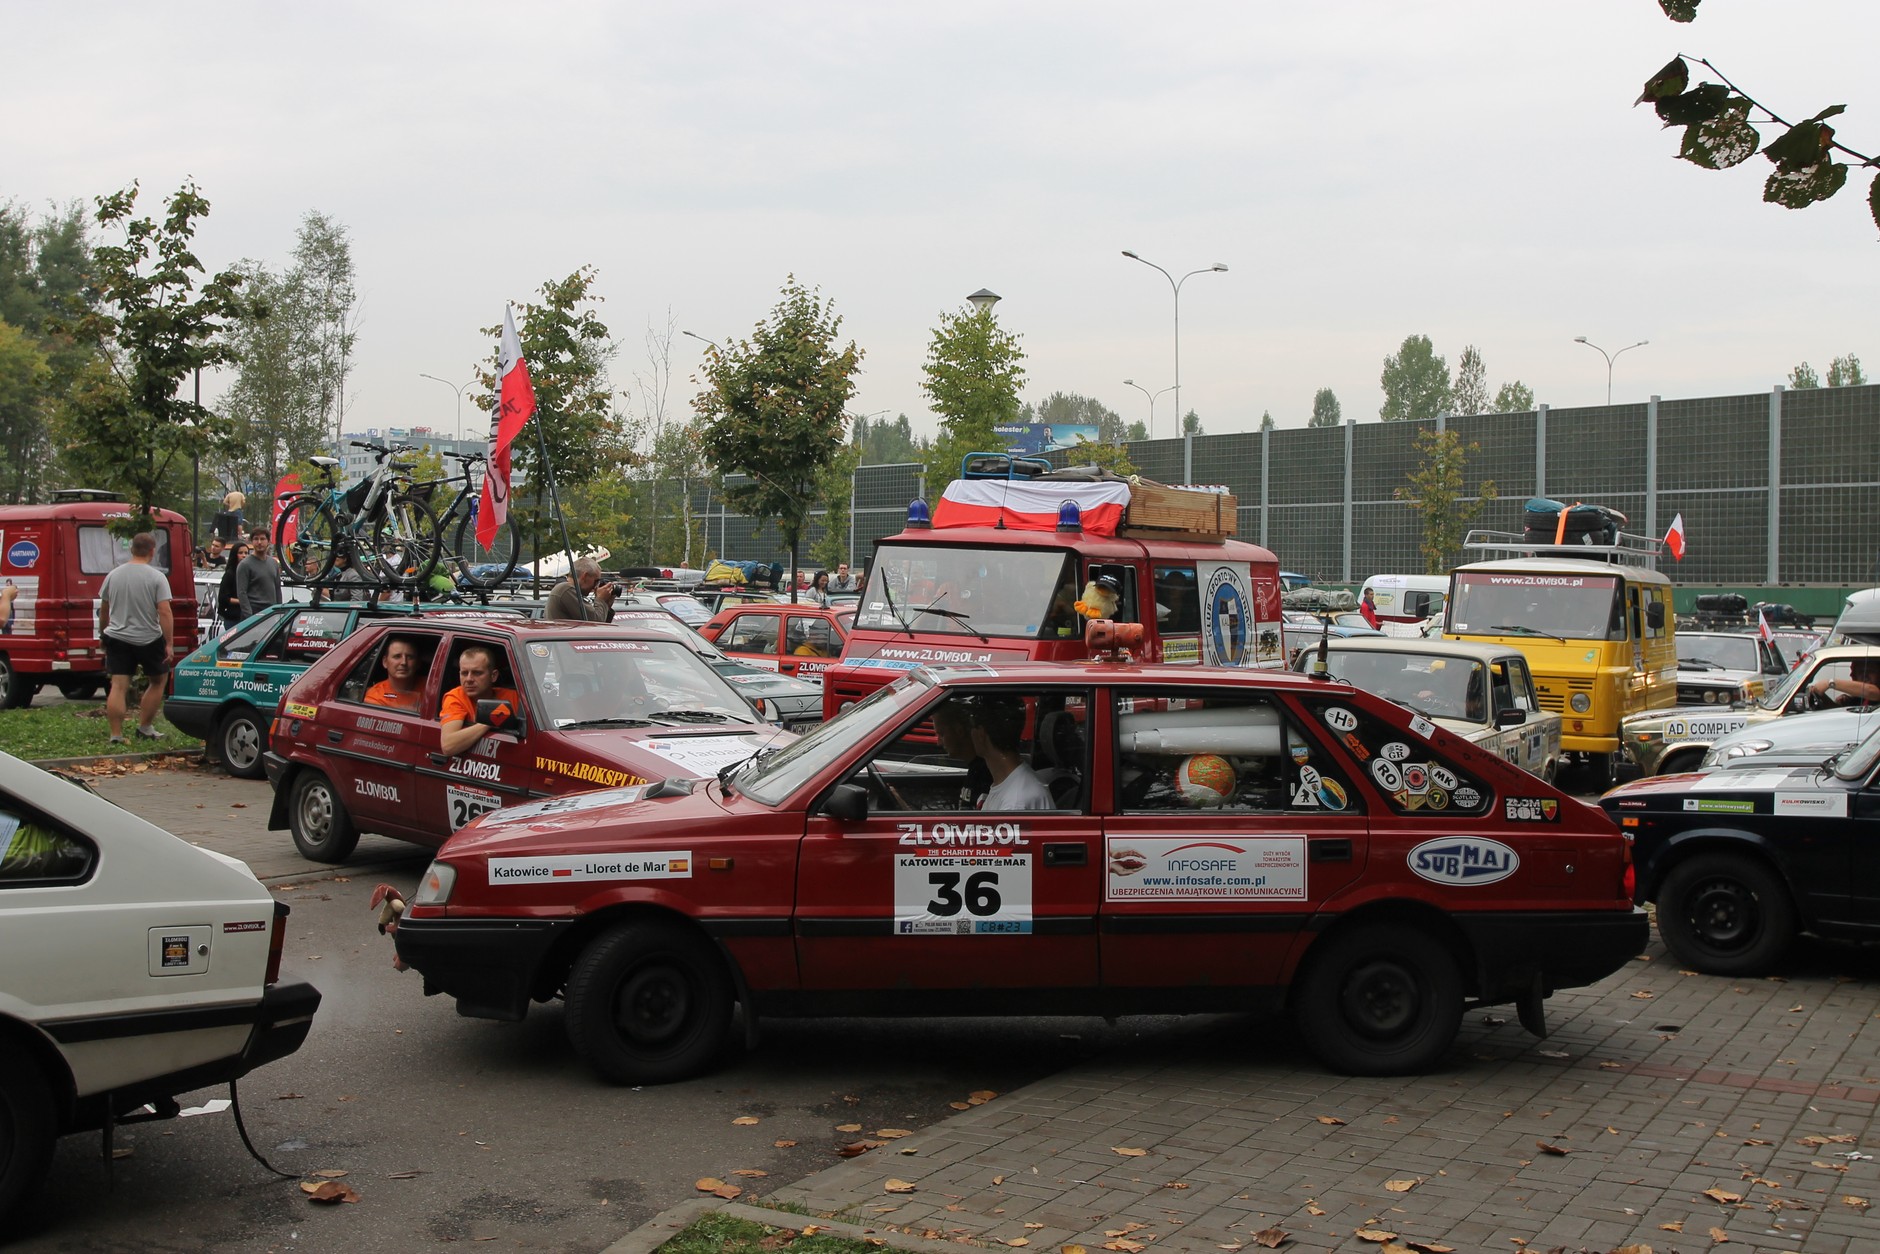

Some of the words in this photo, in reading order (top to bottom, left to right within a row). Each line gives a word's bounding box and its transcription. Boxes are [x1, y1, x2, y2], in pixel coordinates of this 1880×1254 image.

[1490, 576, 1583, 587] www.ZLOMBOL.pl
[307, 616, 324, 627] Mąż
[303, 627, 324, 637] Żona
[233, 680, 273, 693] KATOWICE
[1334, 711, 1347, 727] H
[1669, 724, 1684, 734] AD
[449, 756, 501, 781] ZLOMBOL
[1377, 763, 1397, 785] RO
[1303, 771, 1318, 785] LV
[1434, 770, 1454, 786] MK
[354, 778, 401, 803] ZLOMBOL
[1433, 795, 1440, 803] 7
[897, 823, 1029, 847] ZLOMBOL
[494, 866, 549, 877] Katowice
[586, 864, 621, 874] Lloret
[624, 863, 640, 872] de
[643, 861, 666, 872] Mar
[1168, 860, 1236, 871] INFOSAFE
[1143, 876, 1266, 887] www.infosafe.com.pl
[927, 871, 1002, 917] 36
[1176, 888, 1227, 896] MAJĄTKOWE
[981, 921, 1021, 933] CB#23
